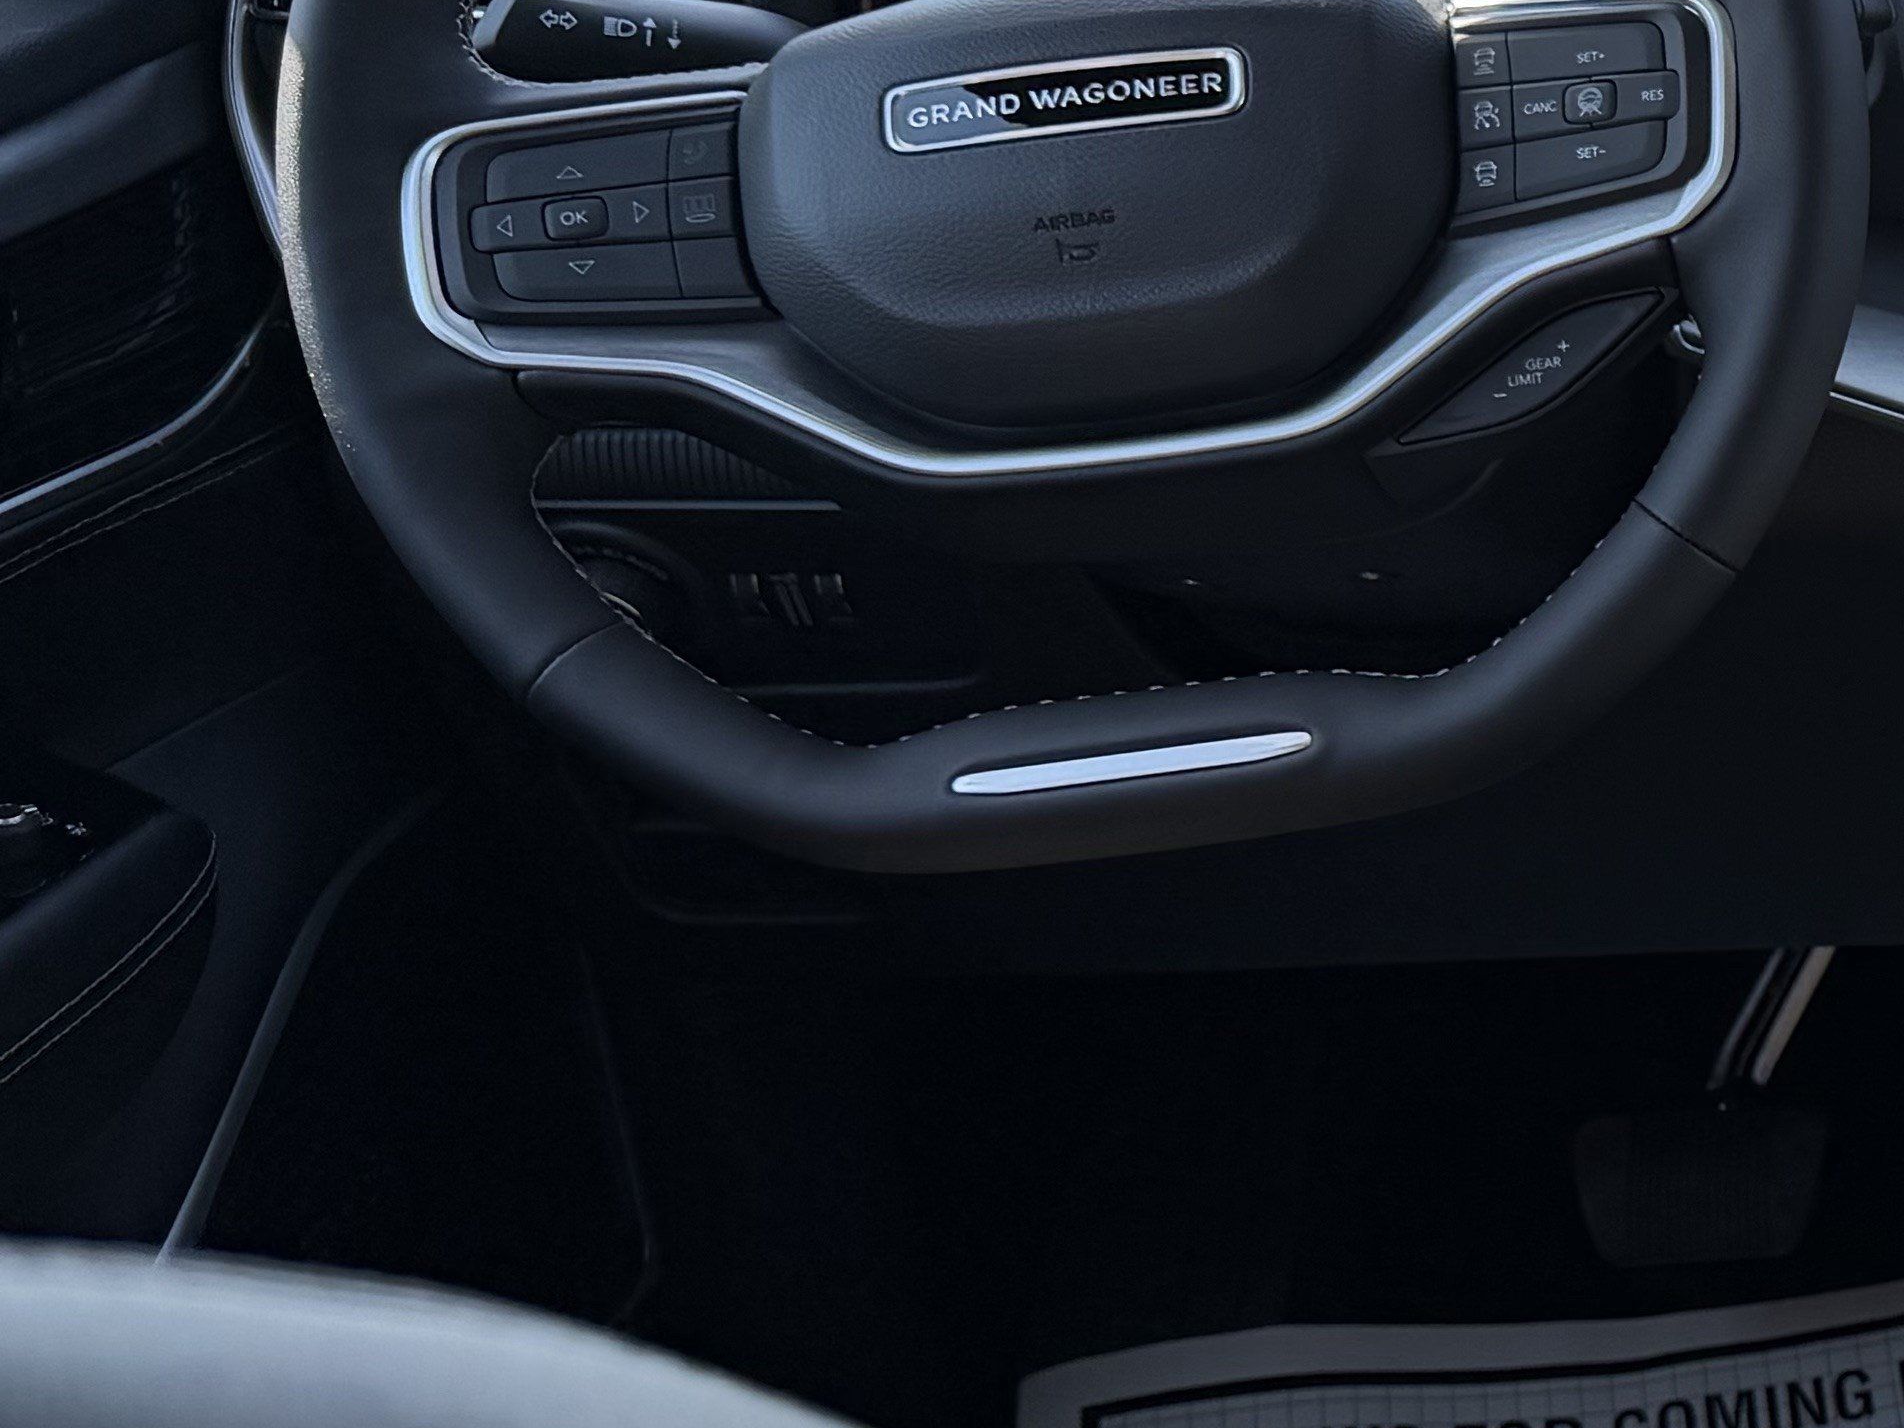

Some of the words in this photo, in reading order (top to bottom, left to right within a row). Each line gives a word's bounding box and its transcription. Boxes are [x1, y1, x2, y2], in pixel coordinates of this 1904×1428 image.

[907, 93, 1021, 128] GRAND
[1028, 72, 1222, 111] WAGONEER
[1641, 88, 1664, 102] RES
[1523, 100, 1558, 115] CANC
[560, 210, 589, 226] OK
[1032, 208, 1116, 234] AIRBAG
[1525, 355, 1562, 371] GEAR
